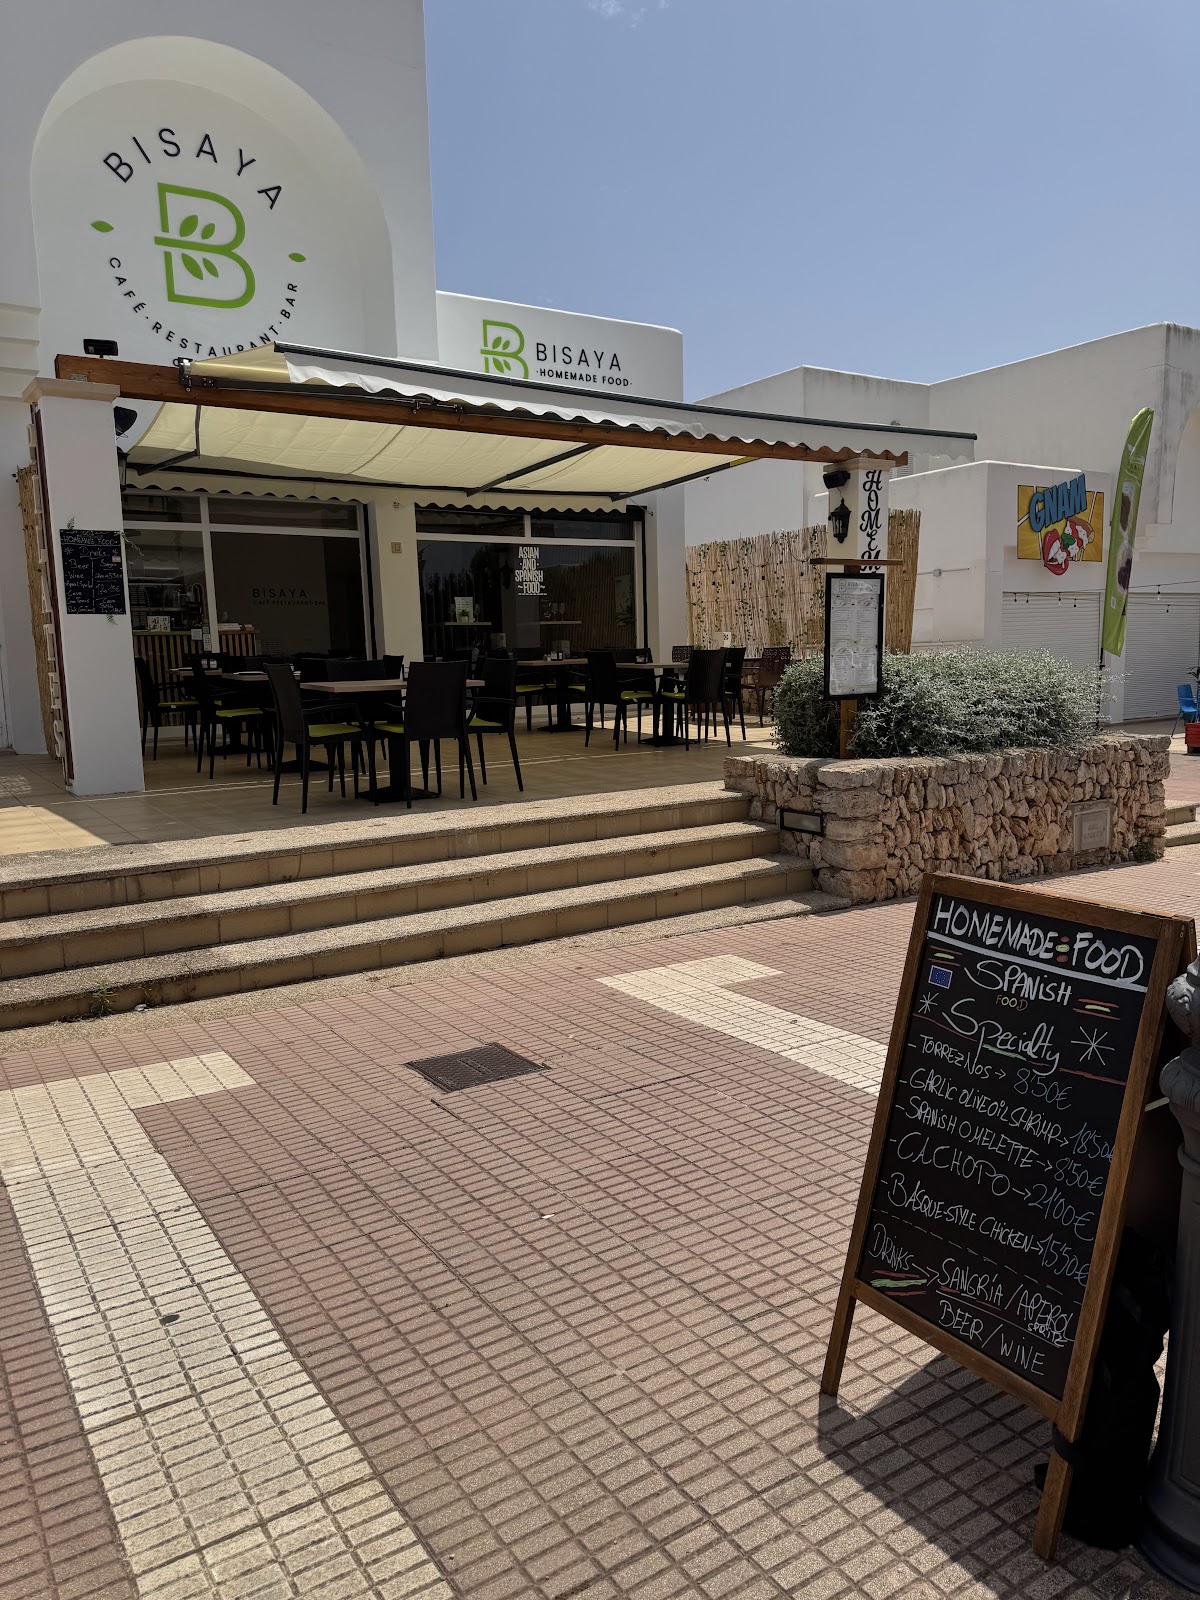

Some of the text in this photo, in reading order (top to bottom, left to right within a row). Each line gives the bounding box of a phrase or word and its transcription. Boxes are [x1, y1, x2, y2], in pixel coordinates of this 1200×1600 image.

[103, 128, 282, 210] BISAYA
[109, 257, 147, 314] CAFÉ
[280, 282, 298, 320] BAR
[536, 342, 622, 372] BISAYA
[539, 368, 630, 387] HOMEMADE FOOD
[1029, 473, 1088, 533] GNAM
[518, 546, 540, 559] ASIAN
[522, 558, 537, 570] AND
[252, 588, 307, 599] BISAYA
[514, 570, 544, 582] SPANISH
[523, 582, 541, 593] FOOD
[933, 897, 1144, 984] HOMEMADE FOOD
[964, 960, 1073, 1006] SPANISH
[995, 994, 1029, 1012] FOOD
[919, 1033, 993, 1080] TORREZNOS
[909, 1067, 958, 1101] GARLIC
[1008, 1106, 1062, 1145] SHRIMP
[904, 1096, 958, 1135] SPANISH
[958, 1120, 1040, 1168] OMELETTE
[897, 1131, 1011, 1196] CACHOPO
[979, 1216, 1033, 1253] CHICKEN
[938, 1299, 985, 1342] BEER
[1000, 1332, 1046, 1376] WINE
